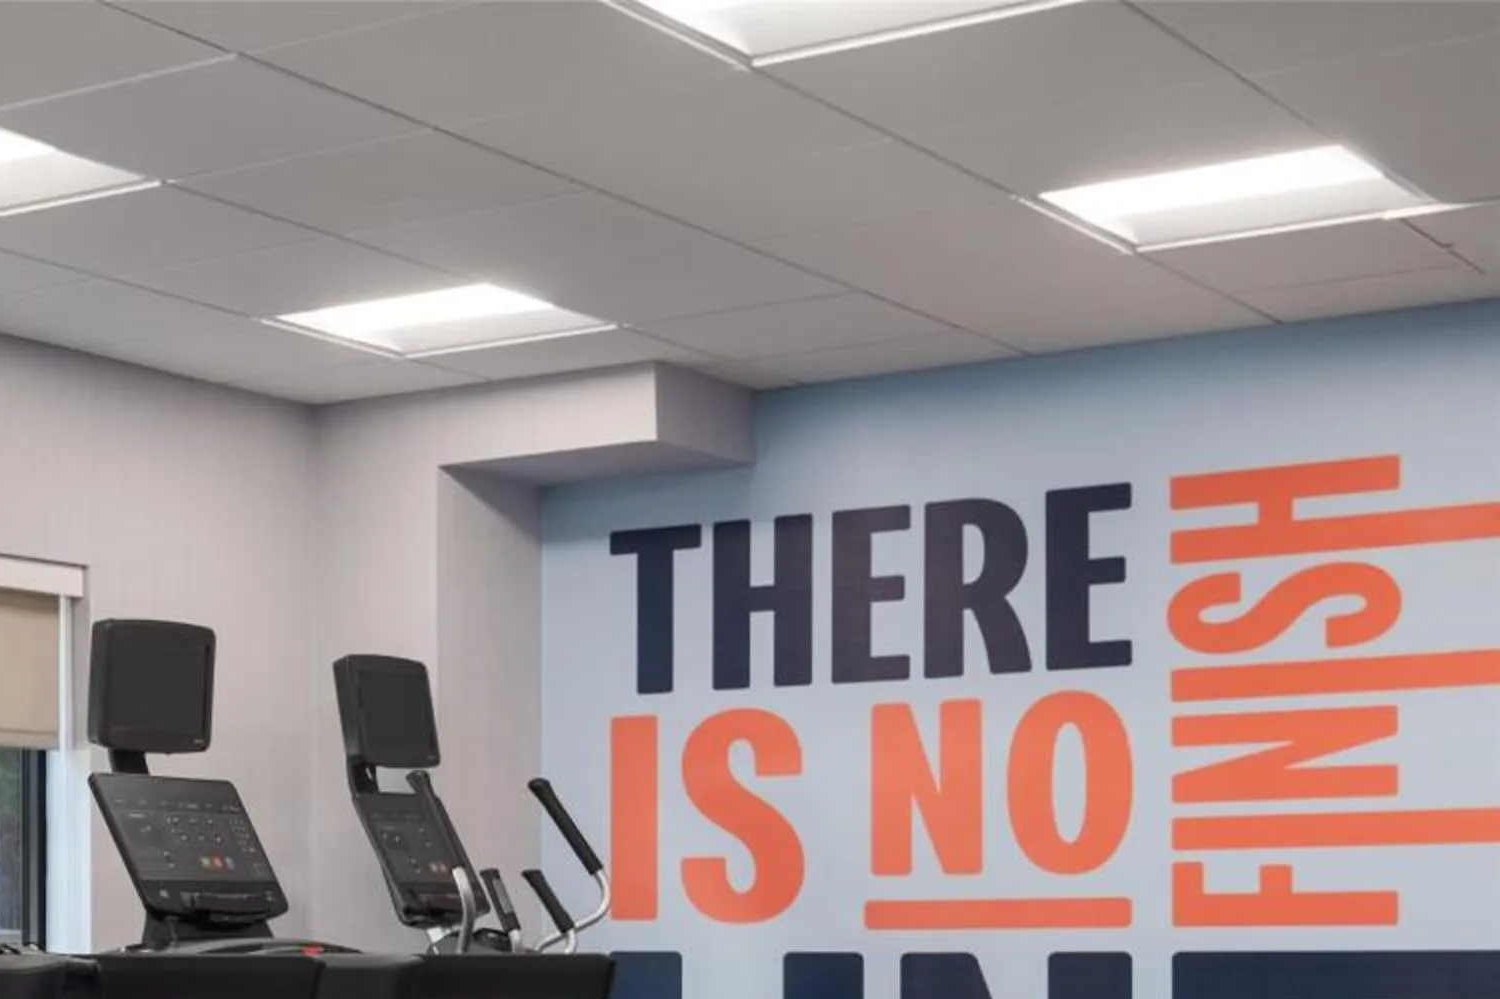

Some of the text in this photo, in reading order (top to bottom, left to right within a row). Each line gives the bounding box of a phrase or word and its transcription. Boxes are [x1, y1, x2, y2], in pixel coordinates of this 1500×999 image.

[607, 480, 1133, 695] THERE
[1168, 454, 1500, 928] FINISH
[610, 690, 1133, 922] IS NO
